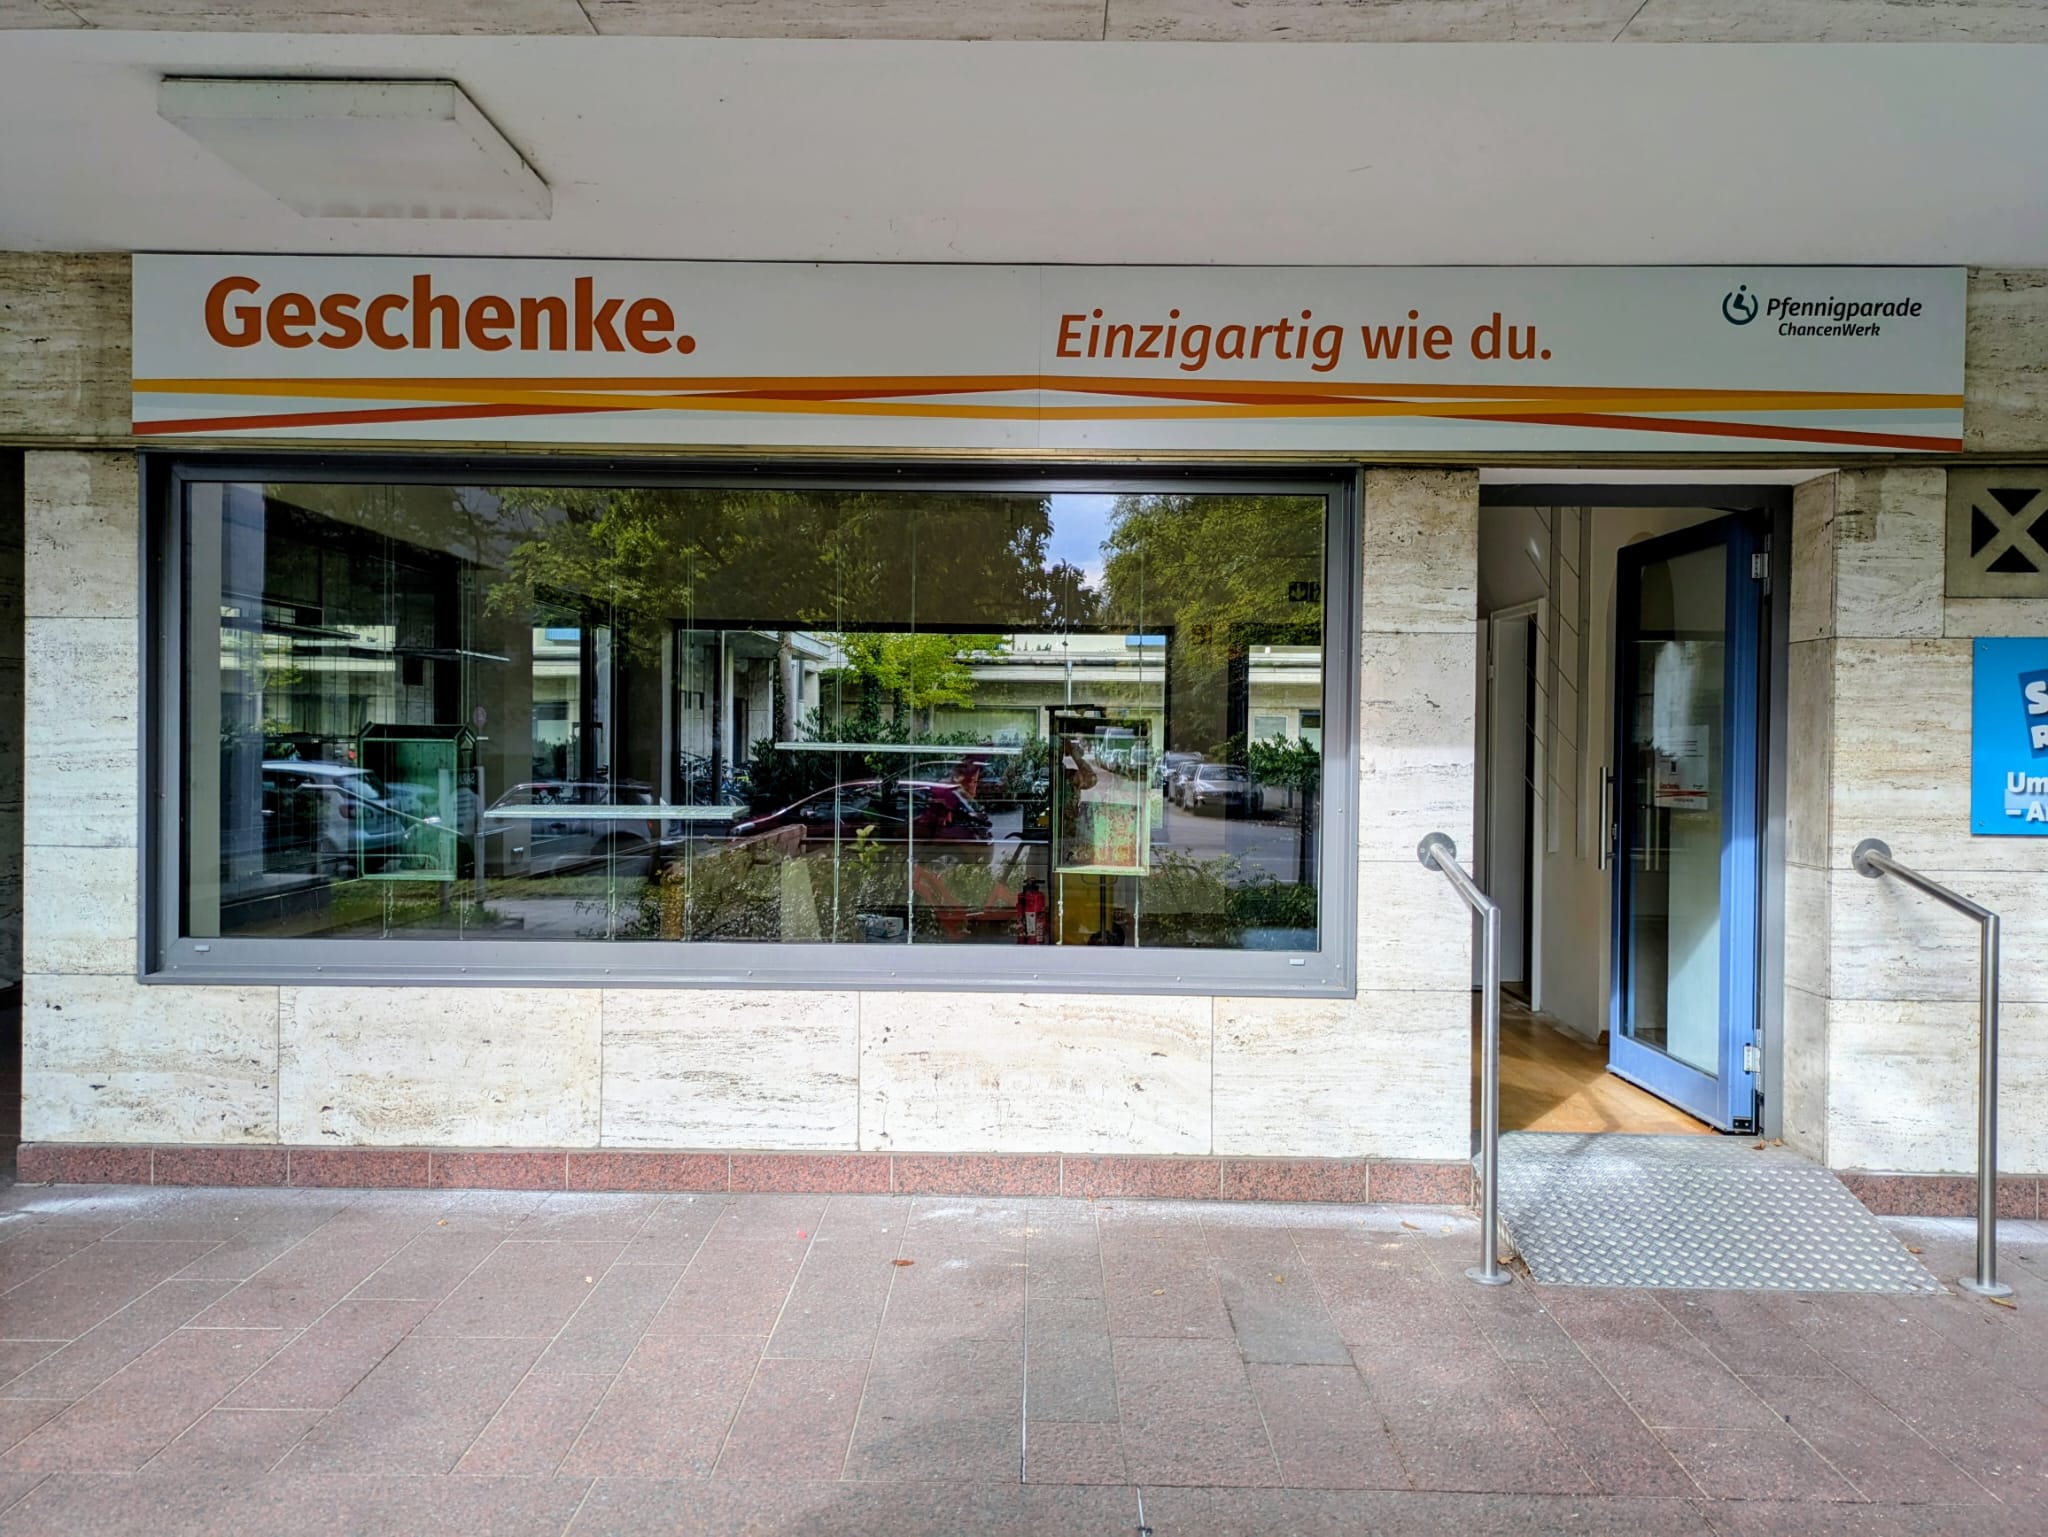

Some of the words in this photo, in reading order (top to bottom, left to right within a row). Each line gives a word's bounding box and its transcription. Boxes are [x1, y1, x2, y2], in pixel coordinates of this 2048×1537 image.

[206, 274, 696, 354] Geschenke.
[1766, 296, 1923, 322] Pfennigparade
[1778, 322, 1881, 337] ChancenWerk
[1057, 308, 1344, 372] Einzigartig
[1361, 310, 1453, 361] wie
[1472, 312, 1553, 360] du.
